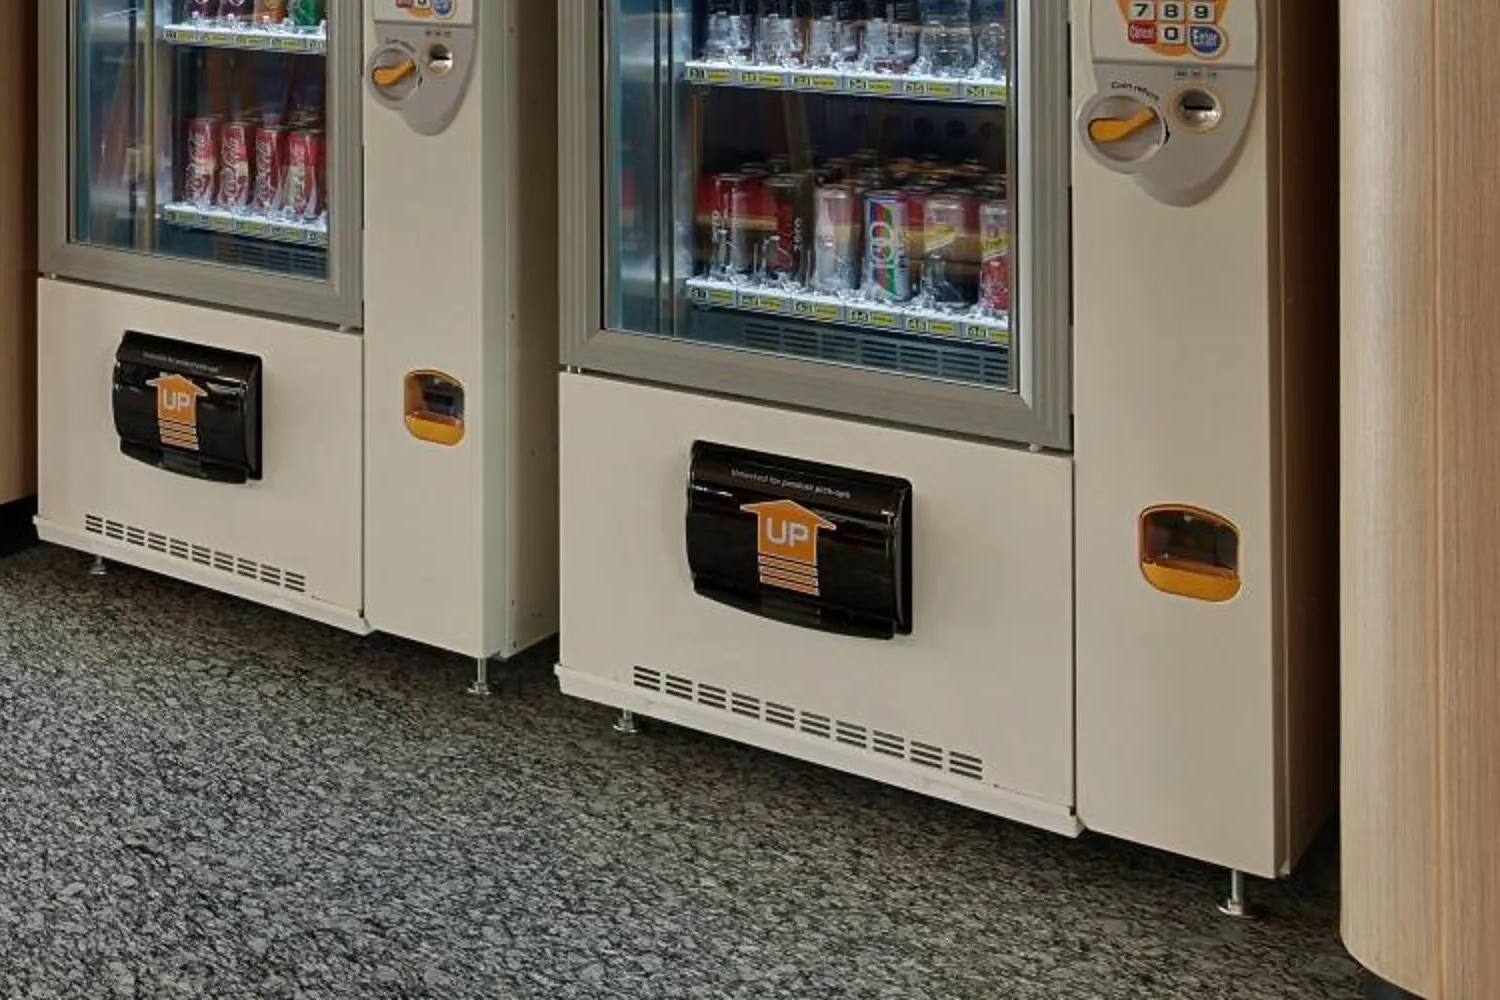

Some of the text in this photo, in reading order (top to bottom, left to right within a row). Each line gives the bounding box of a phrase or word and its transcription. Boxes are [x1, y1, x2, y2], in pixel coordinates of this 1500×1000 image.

[1133, 4, 1209, 18] 7 8 9
[1163, 26, 1179, 41] 0
[163, 389, 191, 412] UP
[765, 516, 809, 548] UP
